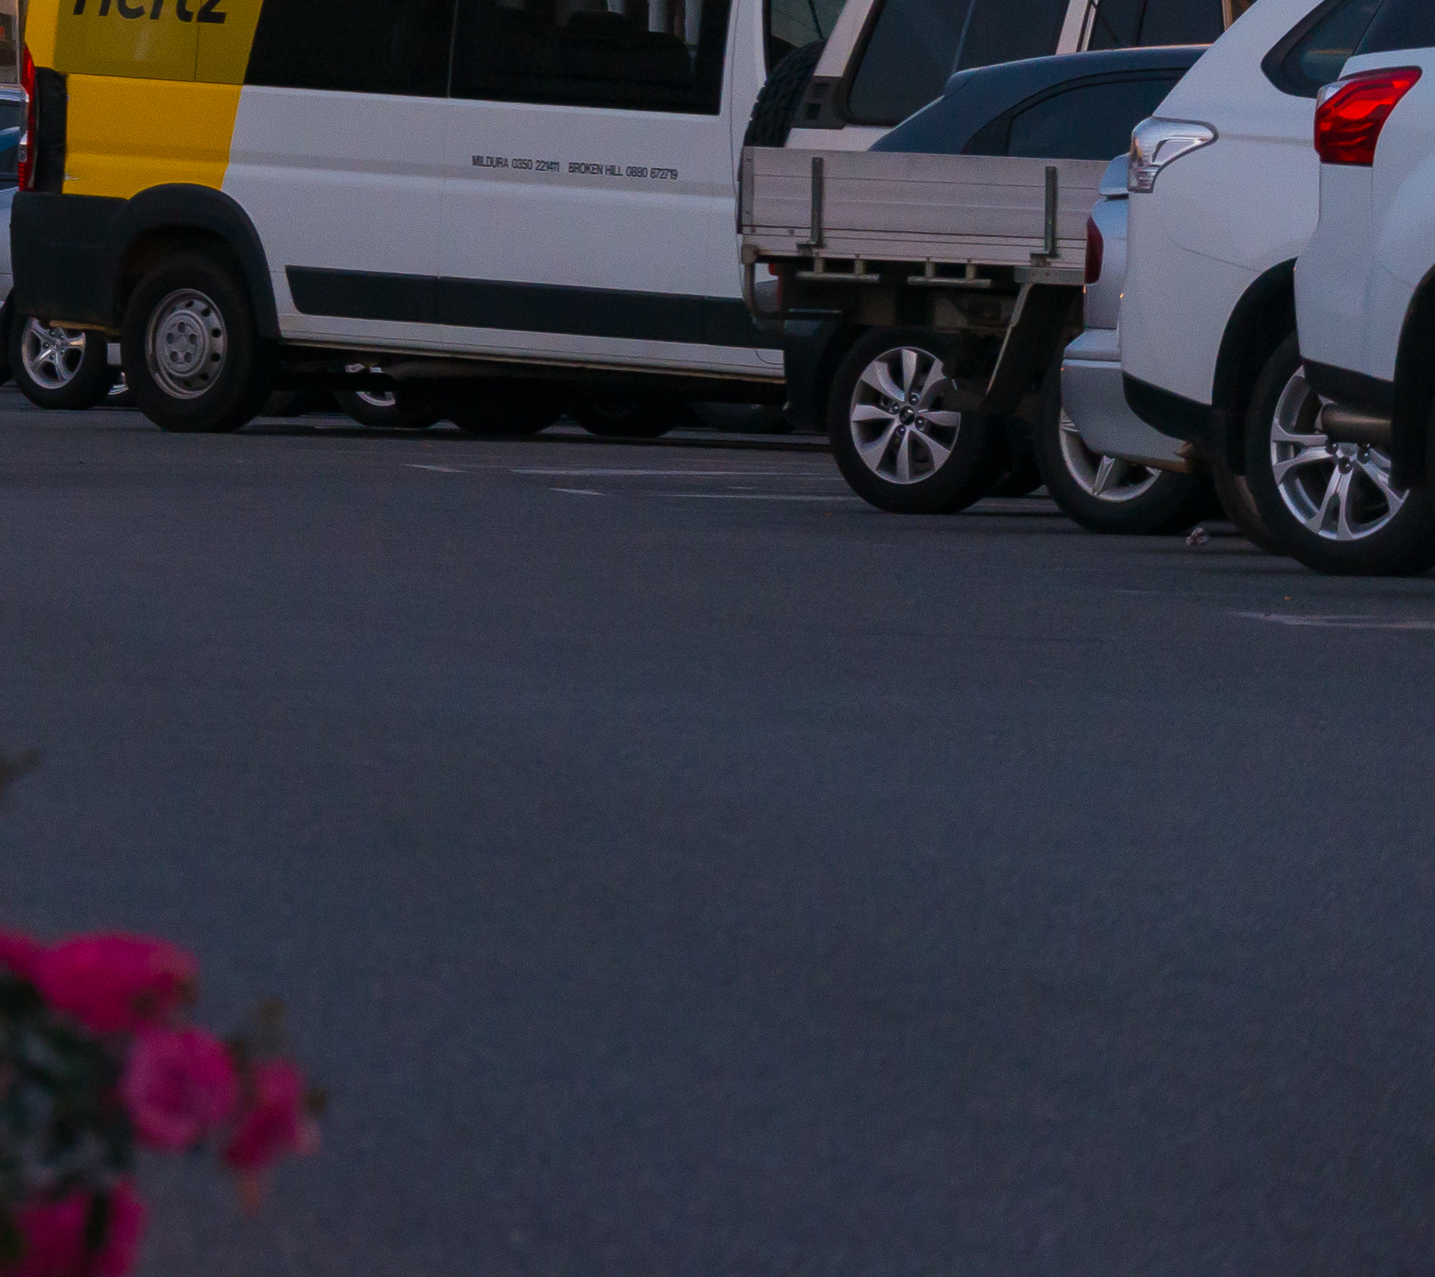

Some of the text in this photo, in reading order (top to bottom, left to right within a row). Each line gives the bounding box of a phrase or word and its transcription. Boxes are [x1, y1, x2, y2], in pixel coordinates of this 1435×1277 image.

[472, 155, 509, 168] MILDURA
[568, 162, 603, 175] BROKEN
[605, 164, 623, 176] HILL
